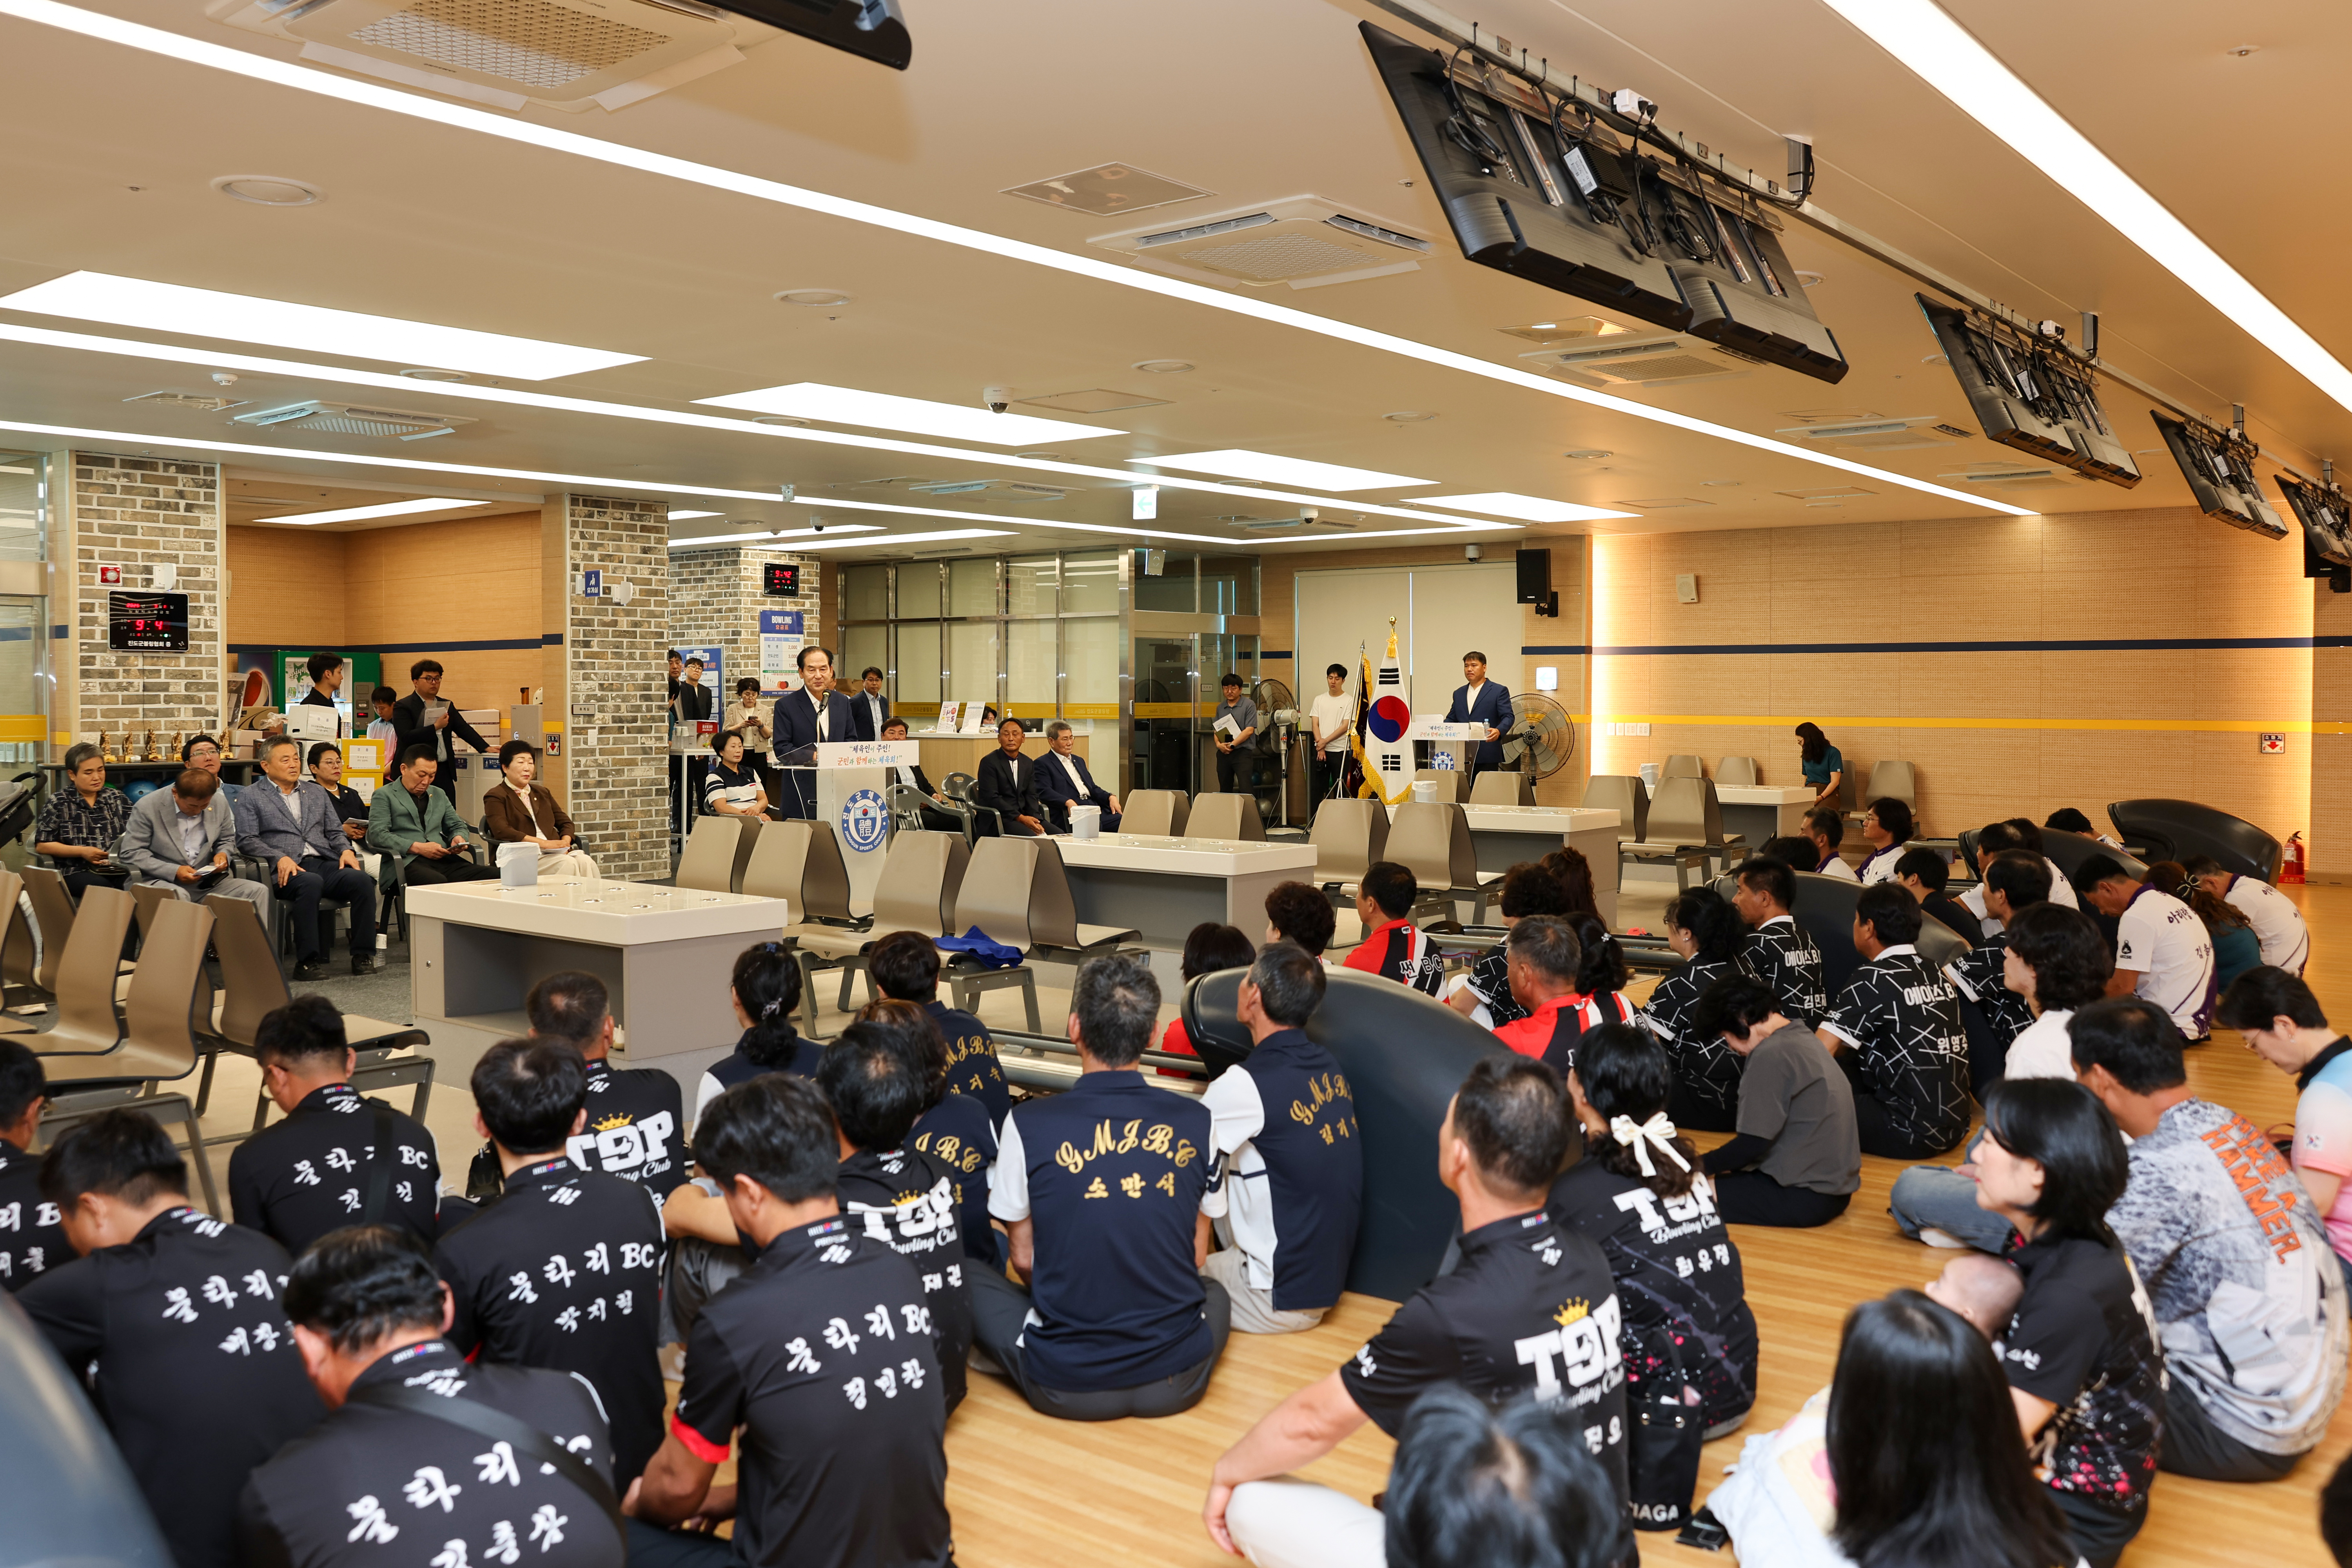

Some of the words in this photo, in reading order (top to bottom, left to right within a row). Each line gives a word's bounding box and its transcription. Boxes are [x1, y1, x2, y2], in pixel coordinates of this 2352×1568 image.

[771, 615, 792, 624] BOWLING
[876, 744, 891, 753] 주인!
[837, 757, 854, 766] 군민과
[856, 756, 877, 765] 함께하는
[878, 755, 902, 764] 체육회!”
[842, 790, 888, 820] 진도군체육회
[844, 830, 859, 849] JINDOGUN
[873, 829, 886, 846] COUNCIL
[2167, 907, 2193, 924] 아리랑
[1421, 954, 1443, 975] BC
[1784, 949, 1812, 967] 에이스
[1903, 983, 1945, 1006] 에이스
[397, 1145, 428, 1170] BC
[642, 1158, 671, 1178] Club
[2219, 1123, 2274, 1183] LIKE
[2277, 1191, 2296, 1210] A
[1700, 1214, 1721, 1229] Club
[508, 1241, 610, 1304] 울타리
[619, 1242, 655, 1269] BC
[162, 1269, 275, 1324] 울타리
[784, 1304, 895, 1374] 울타리
[900, 1303, 931, 1336] BC
[347, 1441, 521, 1544] 울타리
